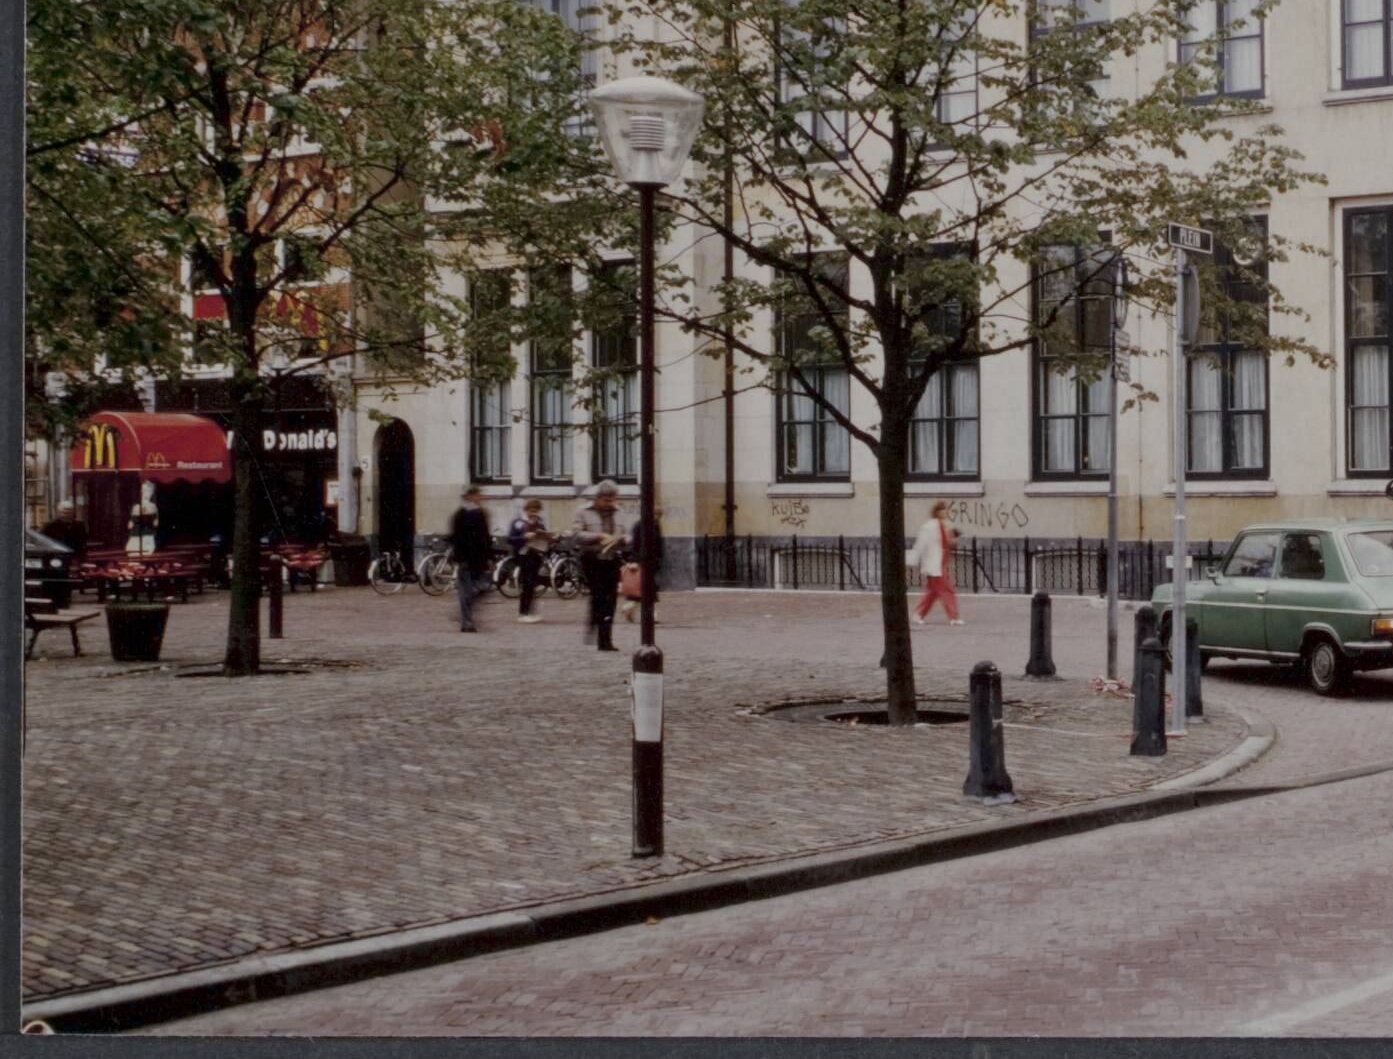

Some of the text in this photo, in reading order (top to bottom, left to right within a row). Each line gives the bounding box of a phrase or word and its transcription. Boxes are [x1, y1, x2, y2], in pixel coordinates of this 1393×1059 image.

[1180, 226, 1201, 248] PLEIN
[176, 460, 224, 470] Restaurant
[946, 500, 1029, 530] GRINGO
